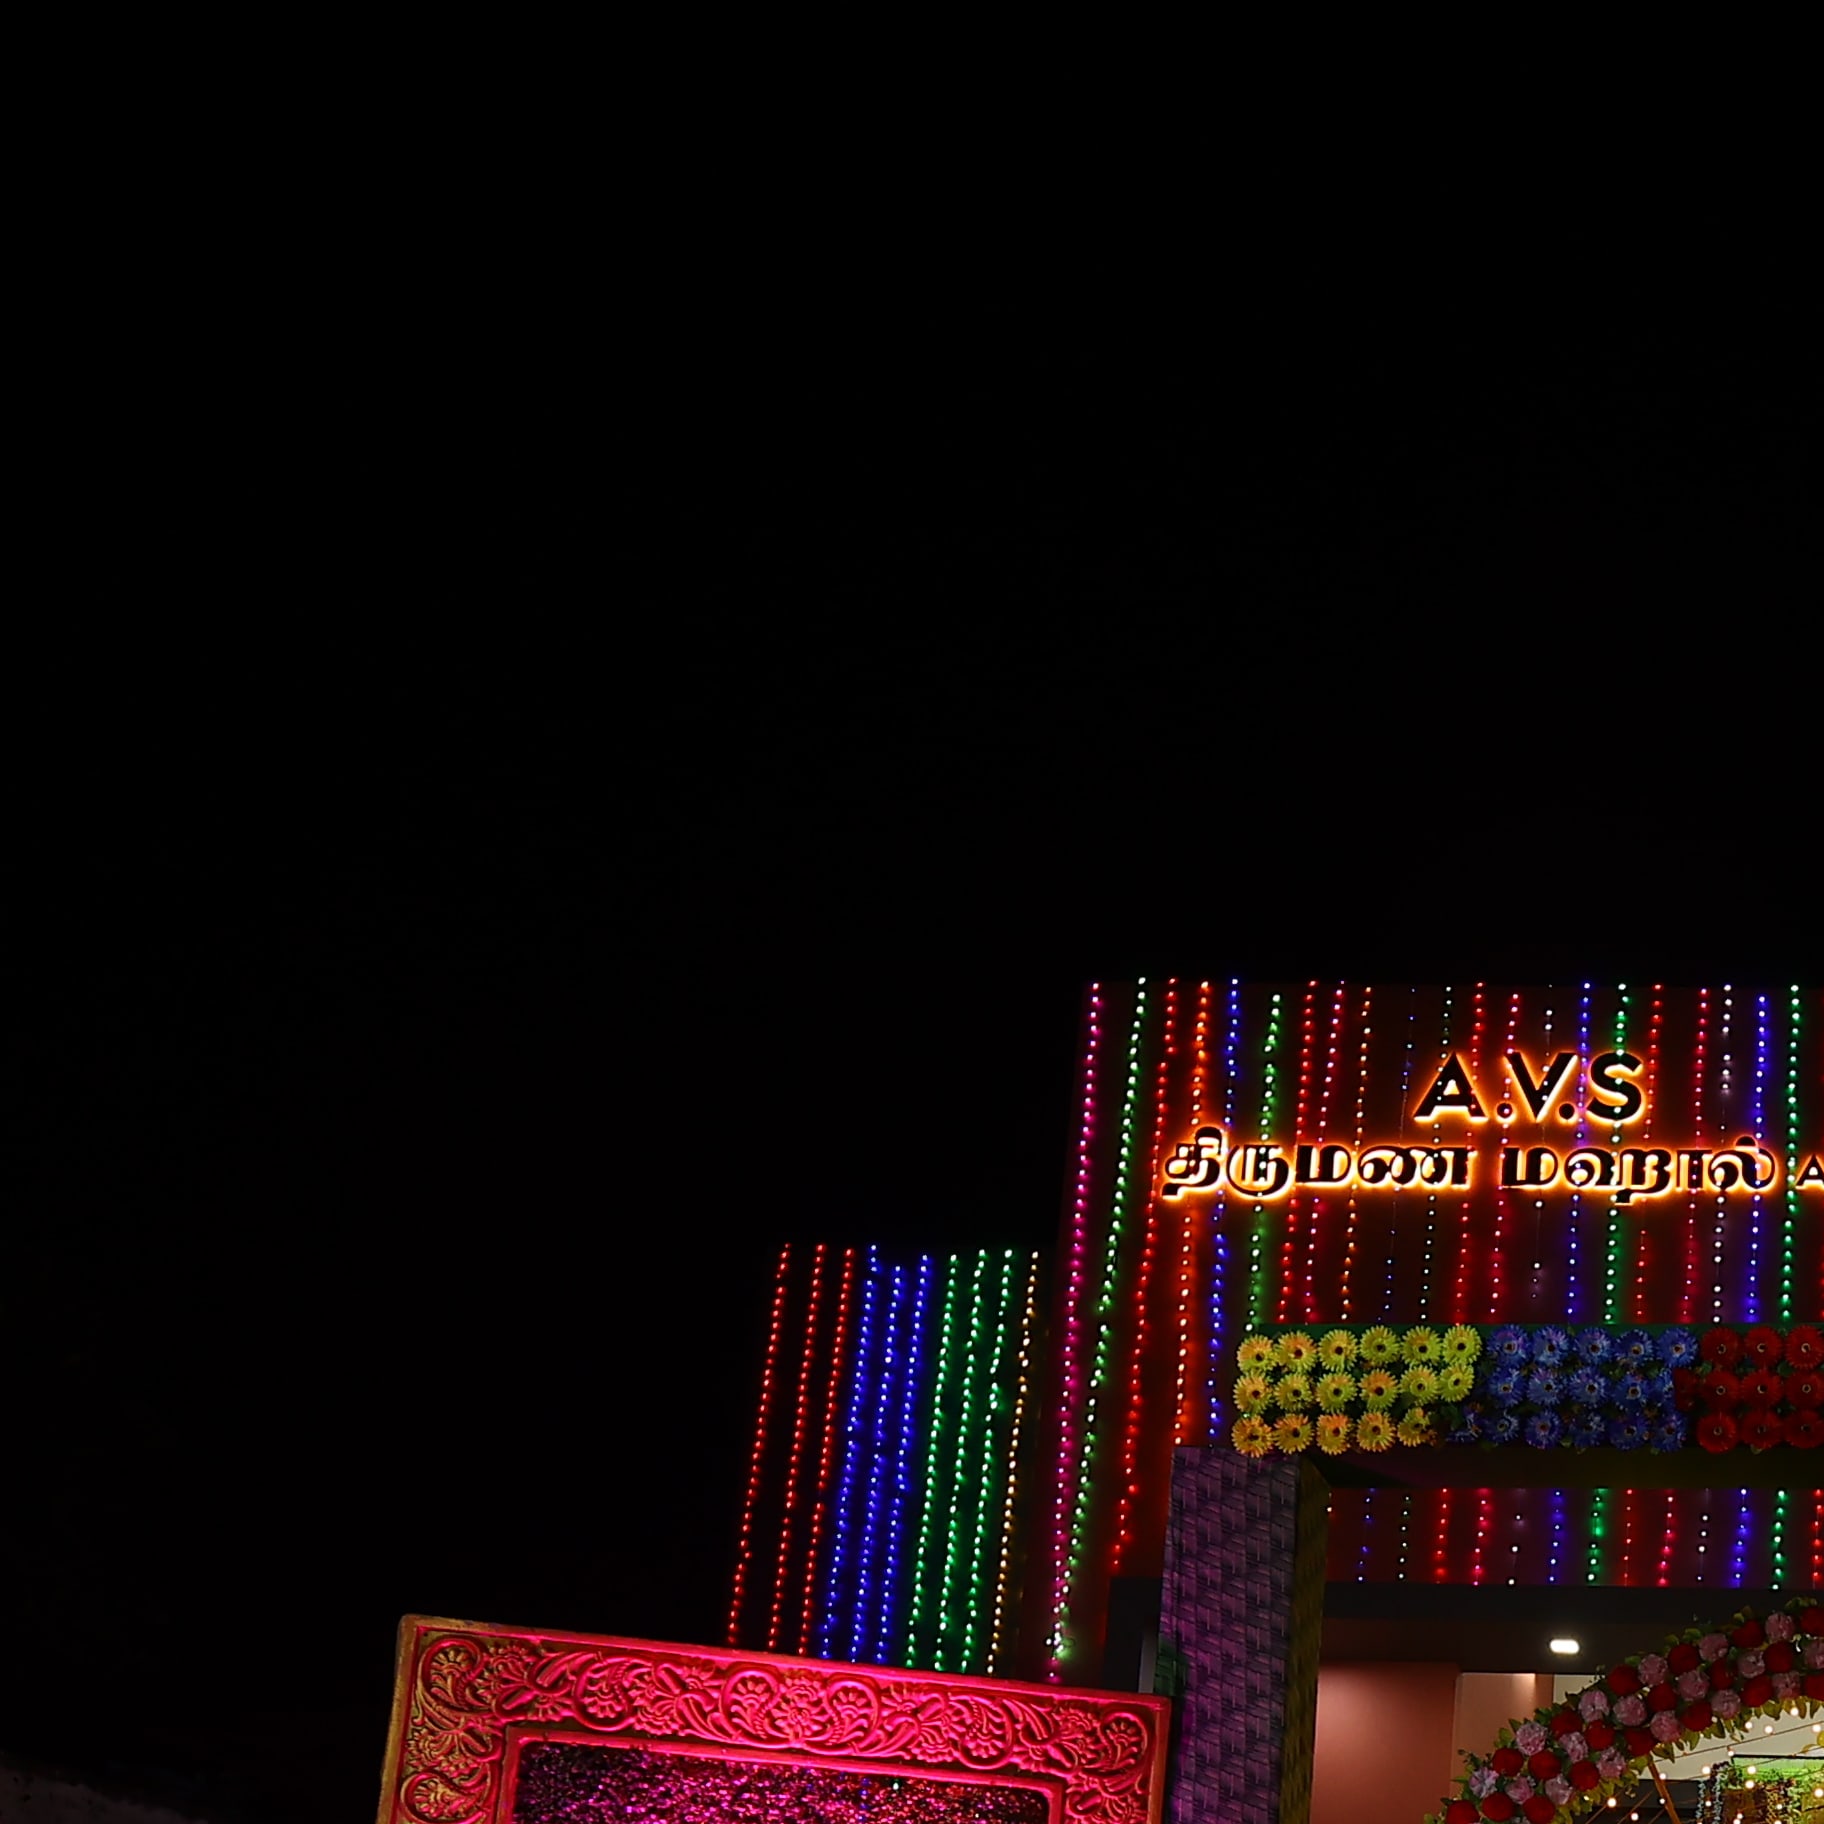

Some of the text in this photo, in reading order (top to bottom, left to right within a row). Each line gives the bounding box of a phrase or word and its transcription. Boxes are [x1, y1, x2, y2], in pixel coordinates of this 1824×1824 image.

[1411, 1050, 1647, 1123] A.V.S
[1160, 1125, 1478, 1201] திருமண
[1499, 1134, 1777, 1206] மஹால்
